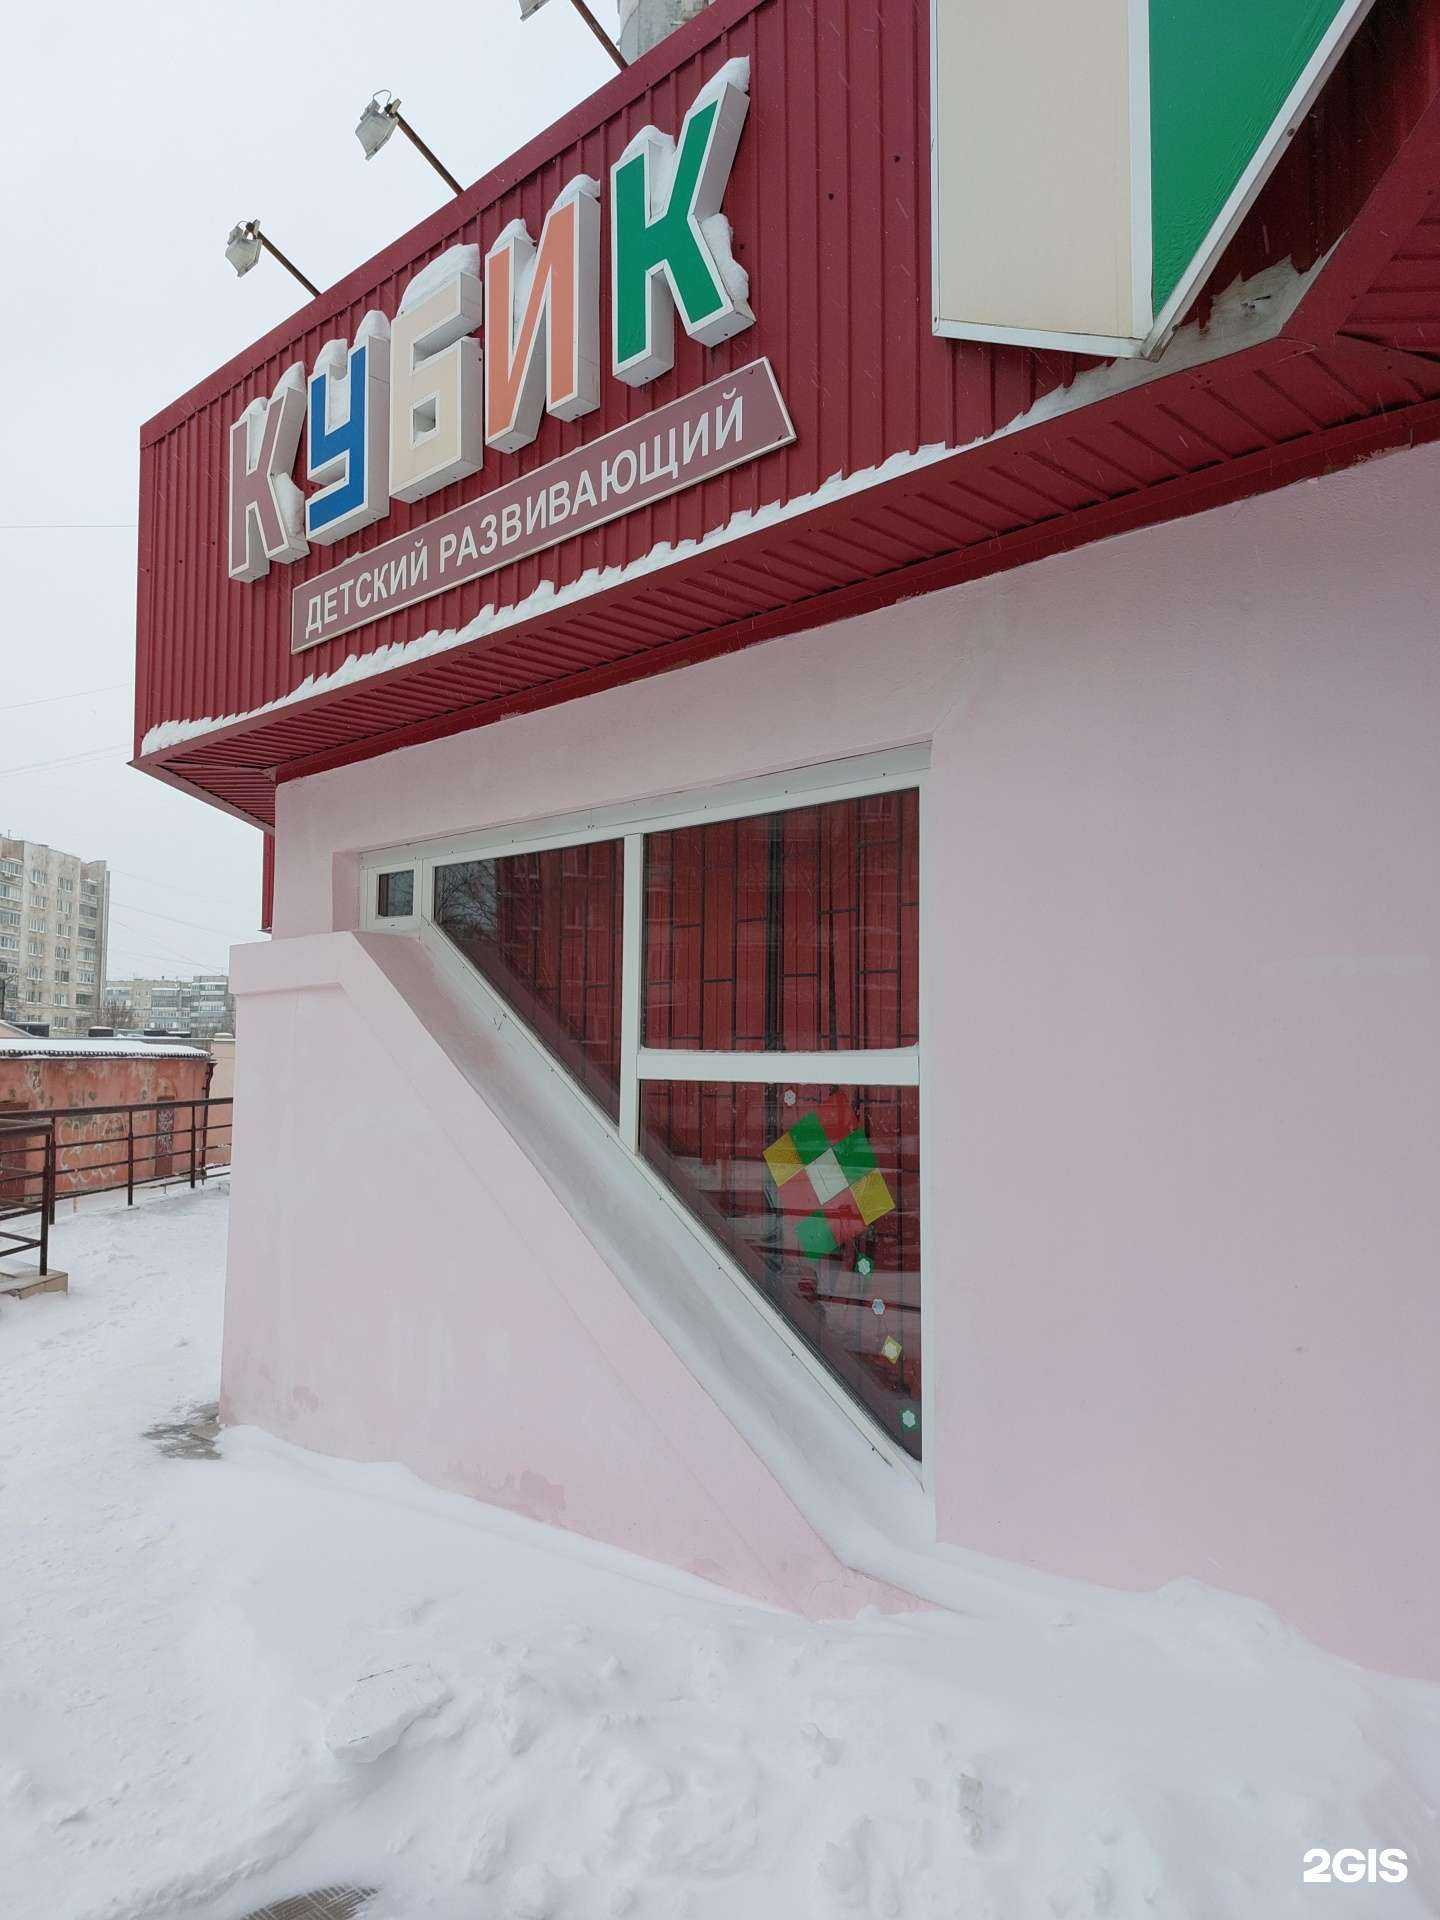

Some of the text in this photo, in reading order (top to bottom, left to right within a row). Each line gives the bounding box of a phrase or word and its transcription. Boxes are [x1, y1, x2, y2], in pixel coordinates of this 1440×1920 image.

[228, 76, 756, 582] КУБИК
[304, 387, 744, 640] ДЕТСКИЙ РАЗВИВАЮЩИЙ
